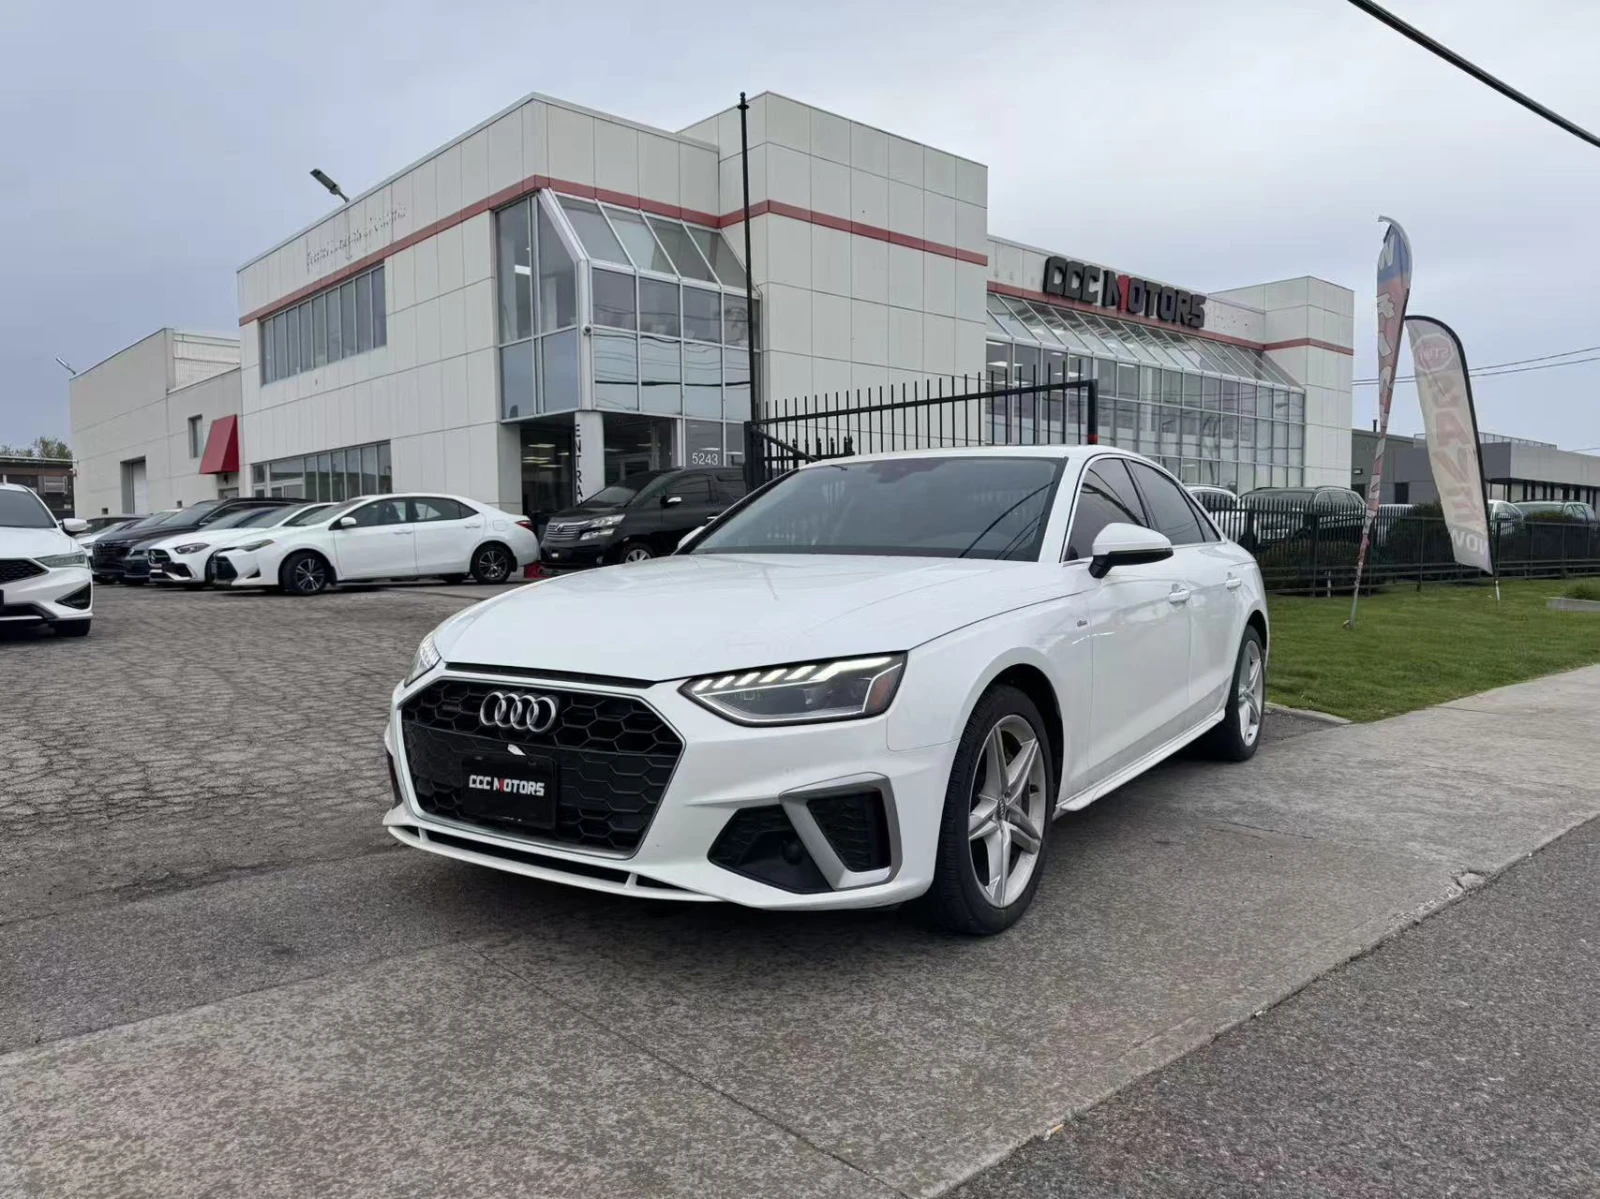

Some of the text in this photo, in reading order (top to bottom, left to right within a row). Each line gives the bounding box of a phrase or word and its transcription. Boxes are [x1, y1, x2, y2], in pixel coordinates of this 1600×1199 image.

[1043, 255, 1207, 329] CCC MOTORS
[575, 423, 584, 505] ENTRA
[692, 452, 719, 466] 5243
[468, 774, 546, 797] CCC MOTORS
